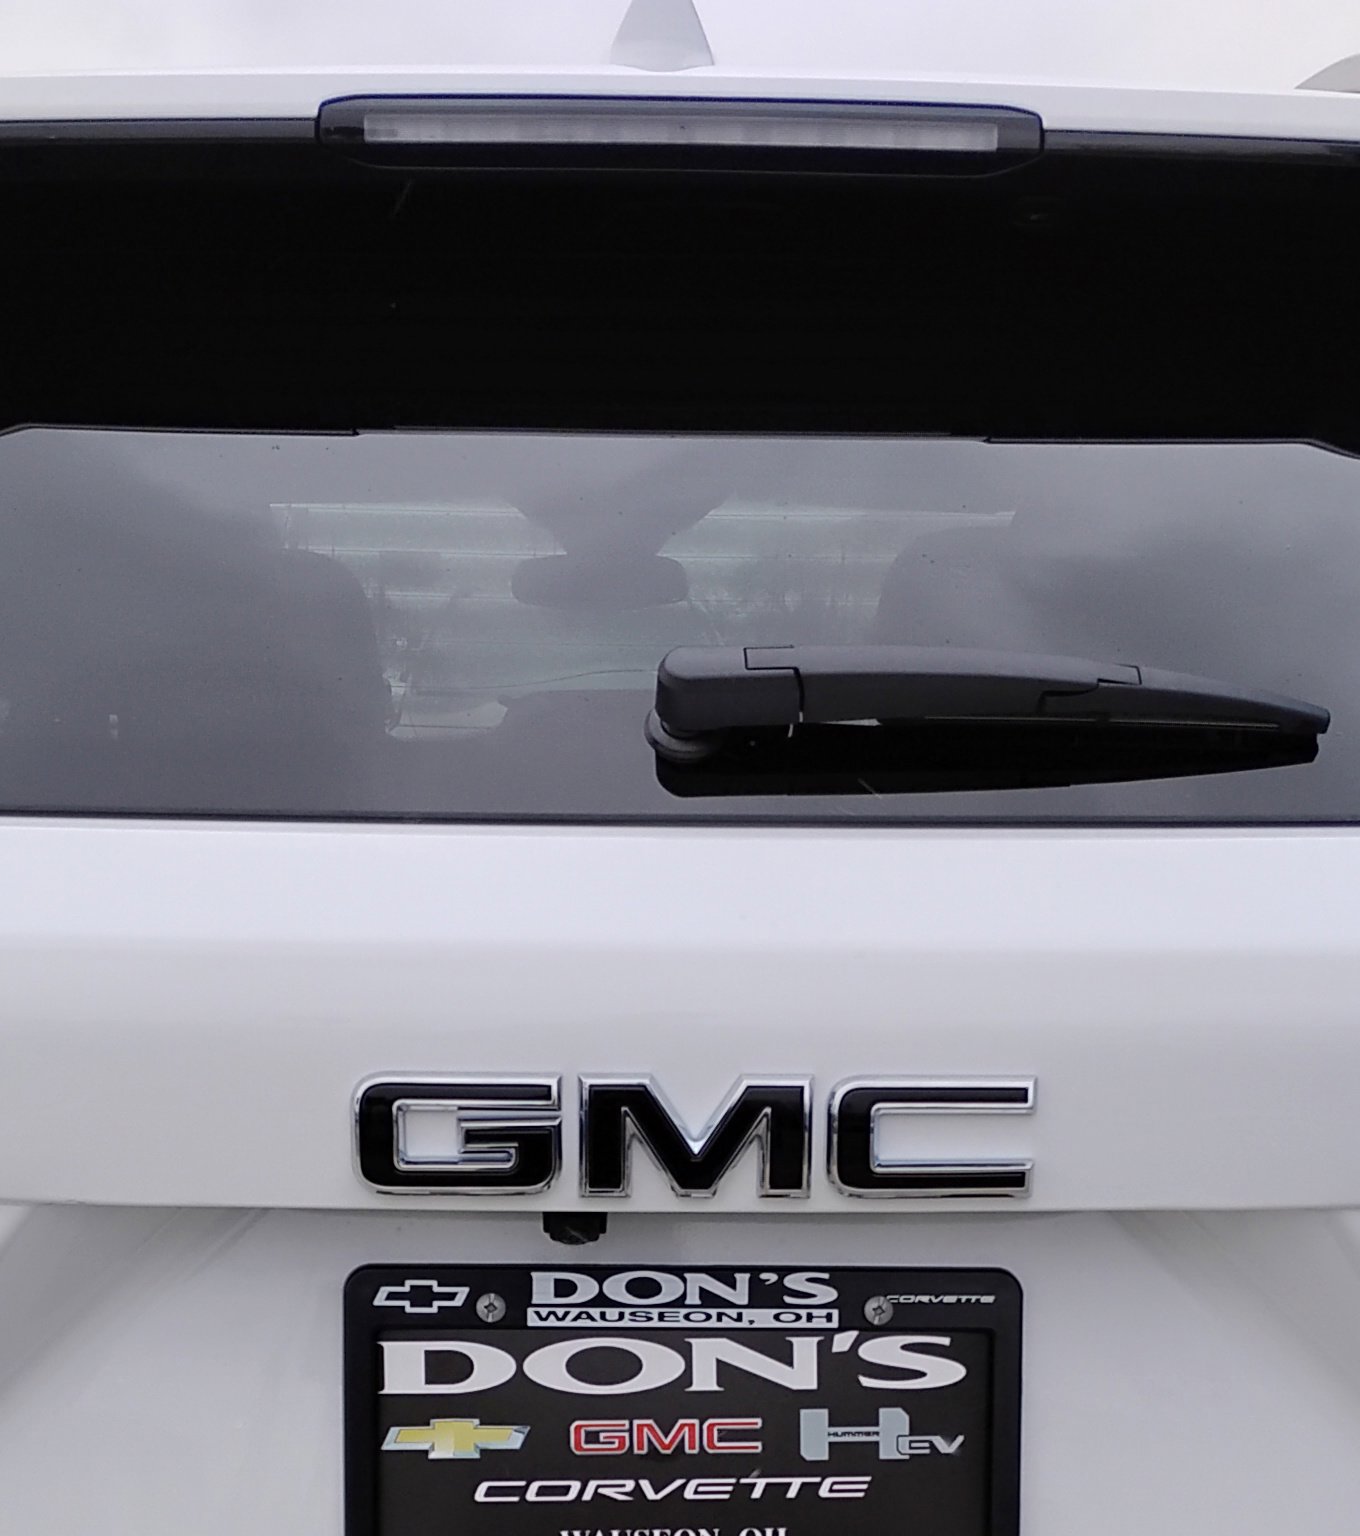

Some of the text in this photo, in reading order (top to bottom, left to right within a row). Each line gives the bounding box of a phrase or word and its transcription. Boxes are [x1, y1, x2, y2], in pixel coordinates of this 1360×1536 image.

[351, 1071, 1038, 1199] GMC
[530, 1270, 839, 1306] DON'S
[886, 1295, 995, 1304] CORVETTE
[533, 1310, 833, 1326] WAUSEON, OH
[378, 1330, 967, 1395] DON'S
[569, 1417, 763, 1456] GMC
[474, 1476, 872, 1503] CORVETTE
